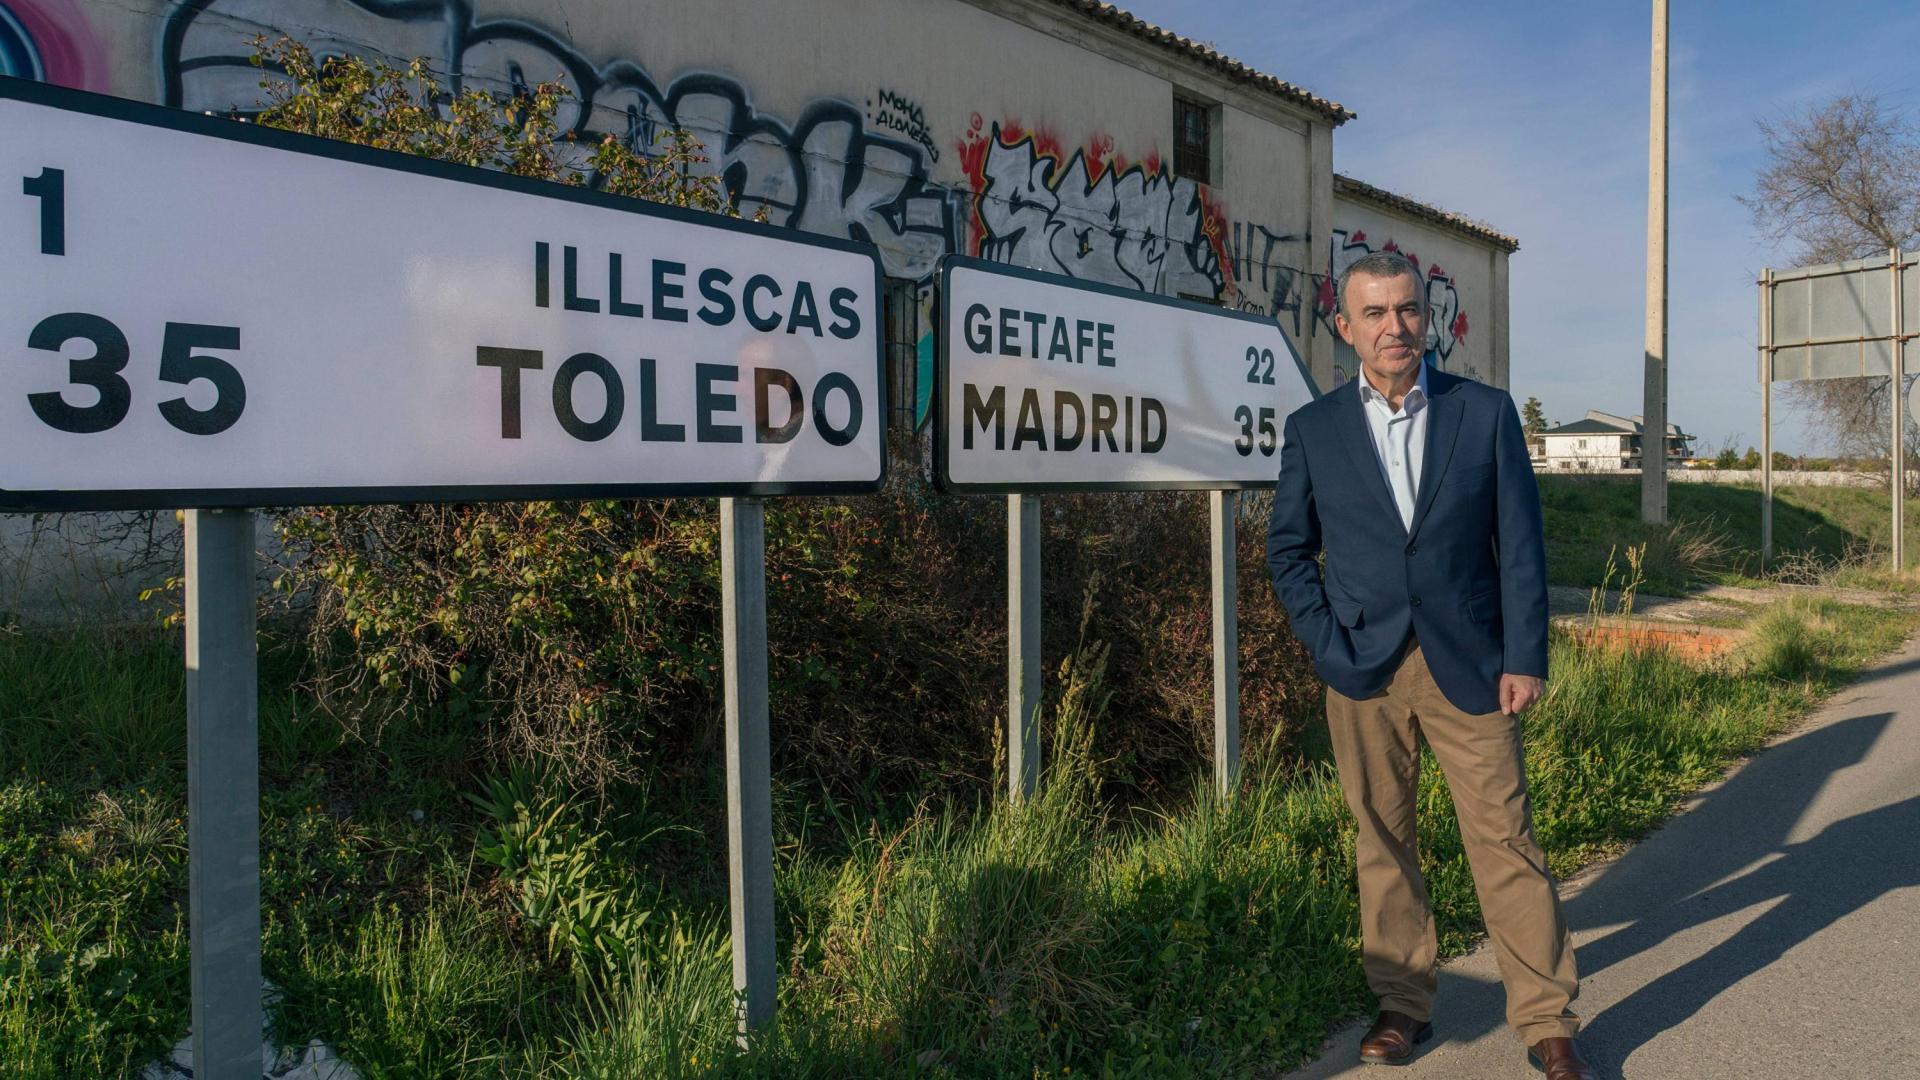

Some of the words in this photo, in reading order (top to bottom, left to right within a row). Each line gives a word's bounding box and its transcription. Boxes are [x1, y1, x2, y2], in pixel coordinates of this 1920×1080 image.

[23, 166, 65, 256] 1
[535, 241, 861, 340] ILLESCAS
[26, 312, 247, 436] 35
[476, 345, 863, 447] TOLEDO
[963, 302, 1117, 368] GETAFE
[1245, 345, 1276, 386] 22
[962, 383, 1168, 454] MADRID
[1234, 404, 1277, 458] 35
